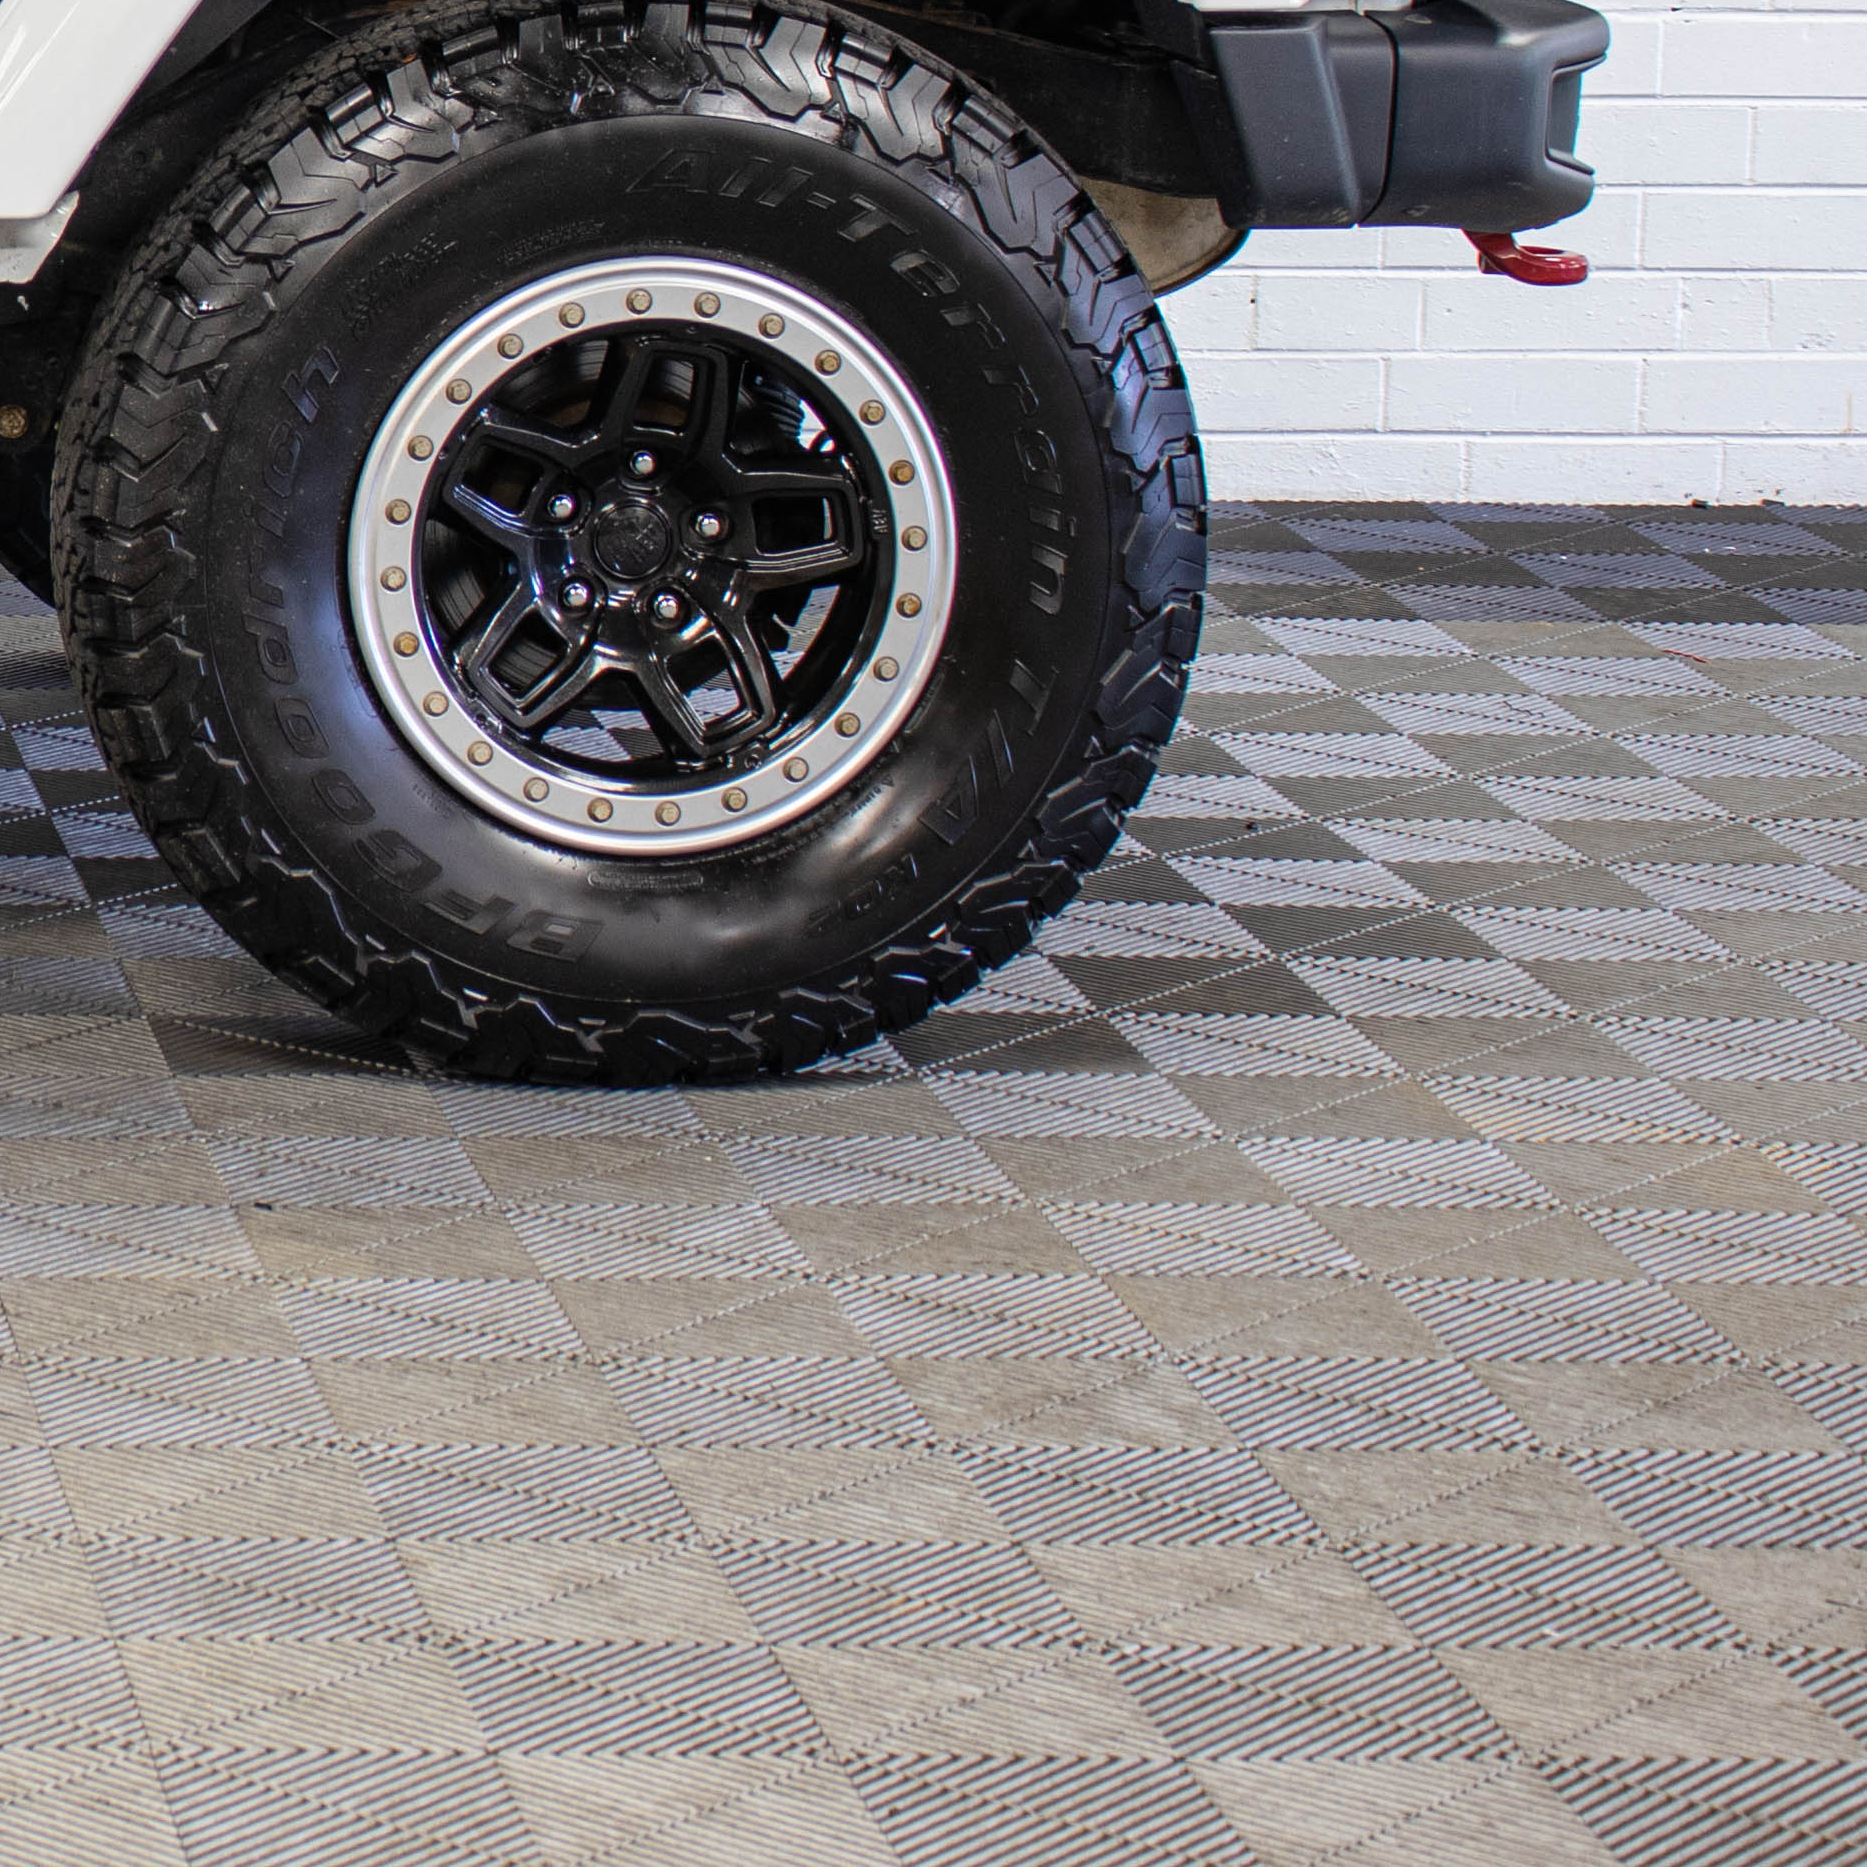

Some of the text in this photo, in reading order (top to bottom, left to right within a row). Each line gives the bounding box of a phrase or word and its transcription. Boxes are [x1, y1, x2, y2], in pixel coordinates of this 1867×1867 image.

[242, 345, 604, 962] BFGoodrich
[625, 147, 1077, 616] All-Terrain
[917, 657, 1060, 847] T/A
